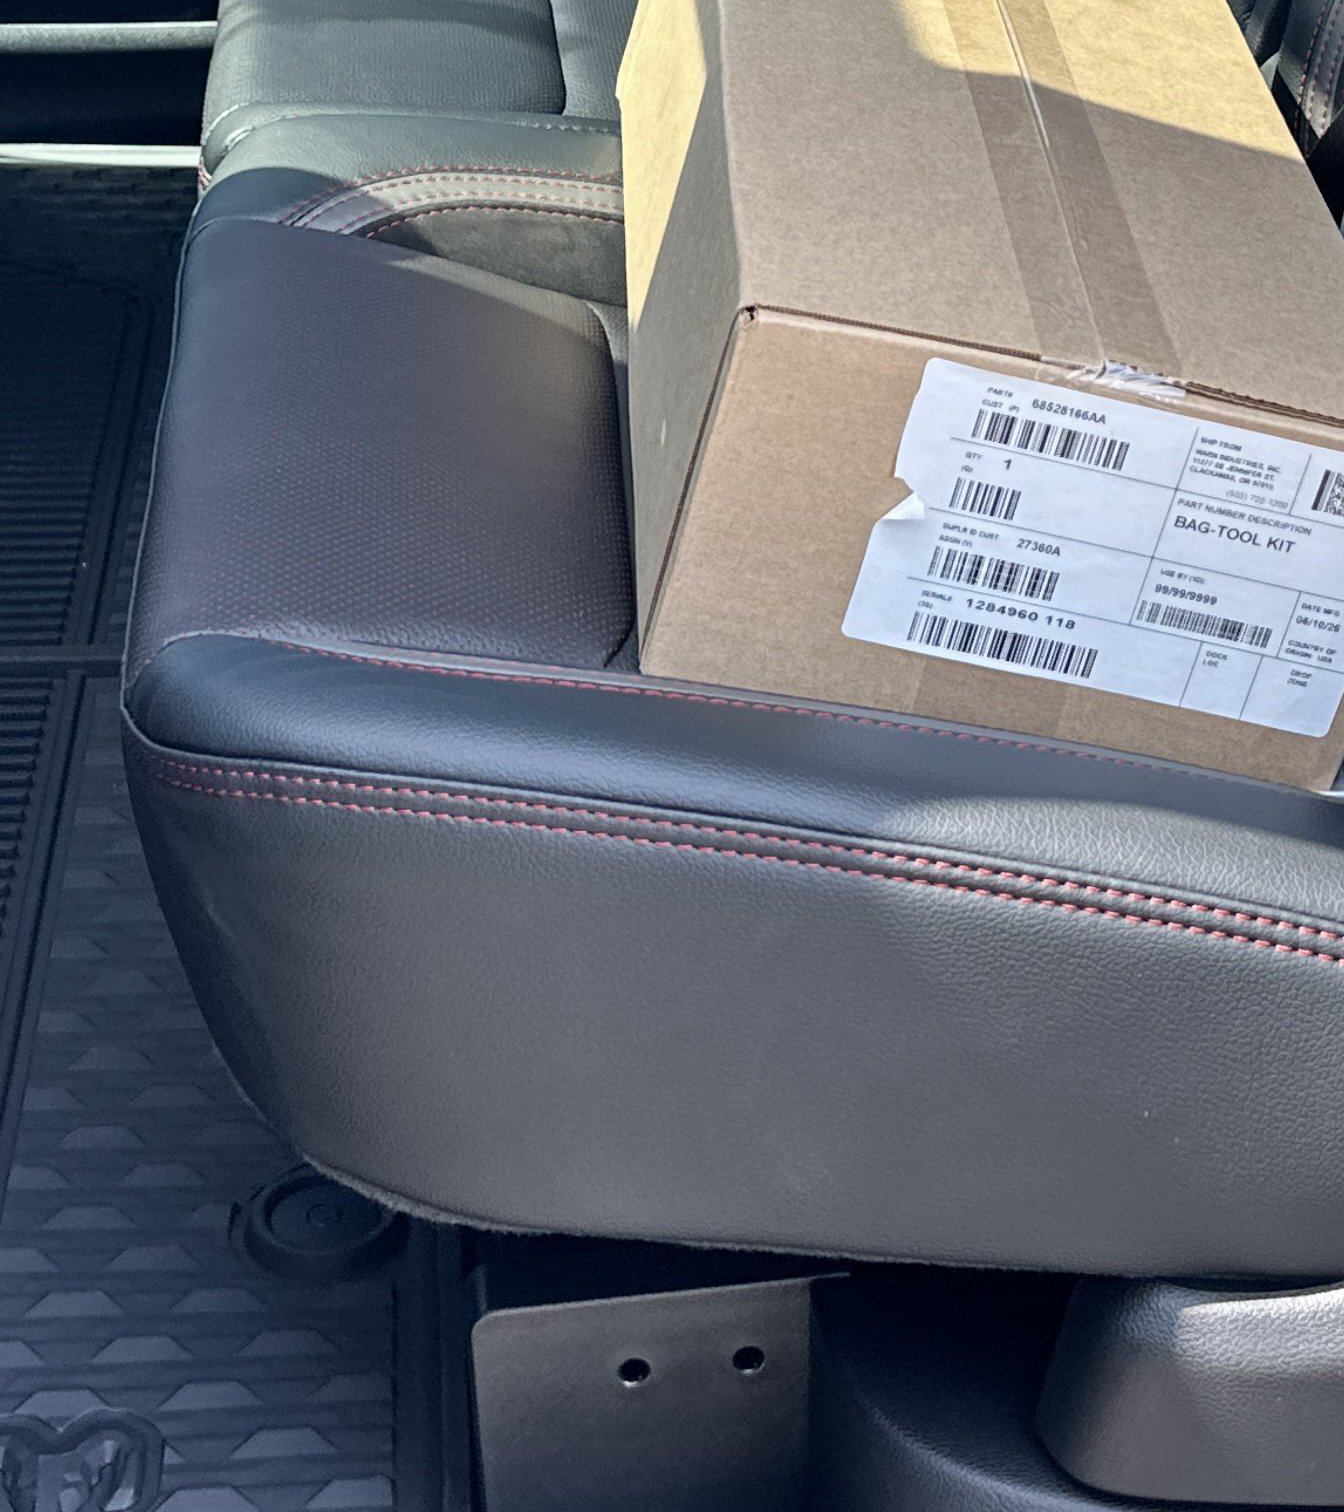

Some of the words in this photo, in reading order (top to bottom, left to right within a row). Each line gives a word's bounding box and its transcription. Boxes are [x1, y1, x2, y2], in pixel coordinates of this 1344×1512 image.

[982, 399, 1004, 408] CUST
[1032, 399, 1107, 424] 68528166AA
[965, 451, 983, 460] QTY
[1004, 458, 1012, 469] 1
[1177, 498, 1204, 509] PART
[1204, 505, 1246, 520] NUMBER
[1247, 514, 1313, 536] DESCRIPTION
[1174, 515, 1262, 547] BAG-TOOL
[1266, 537, 1296, 553] KIT
[1017, 538, 1061, 557] 27360A
[966, 598, 1039, 622] 1284960
[1045, 615, 1076, 630] 118
[1301, 603, 1322, 613] DATE
